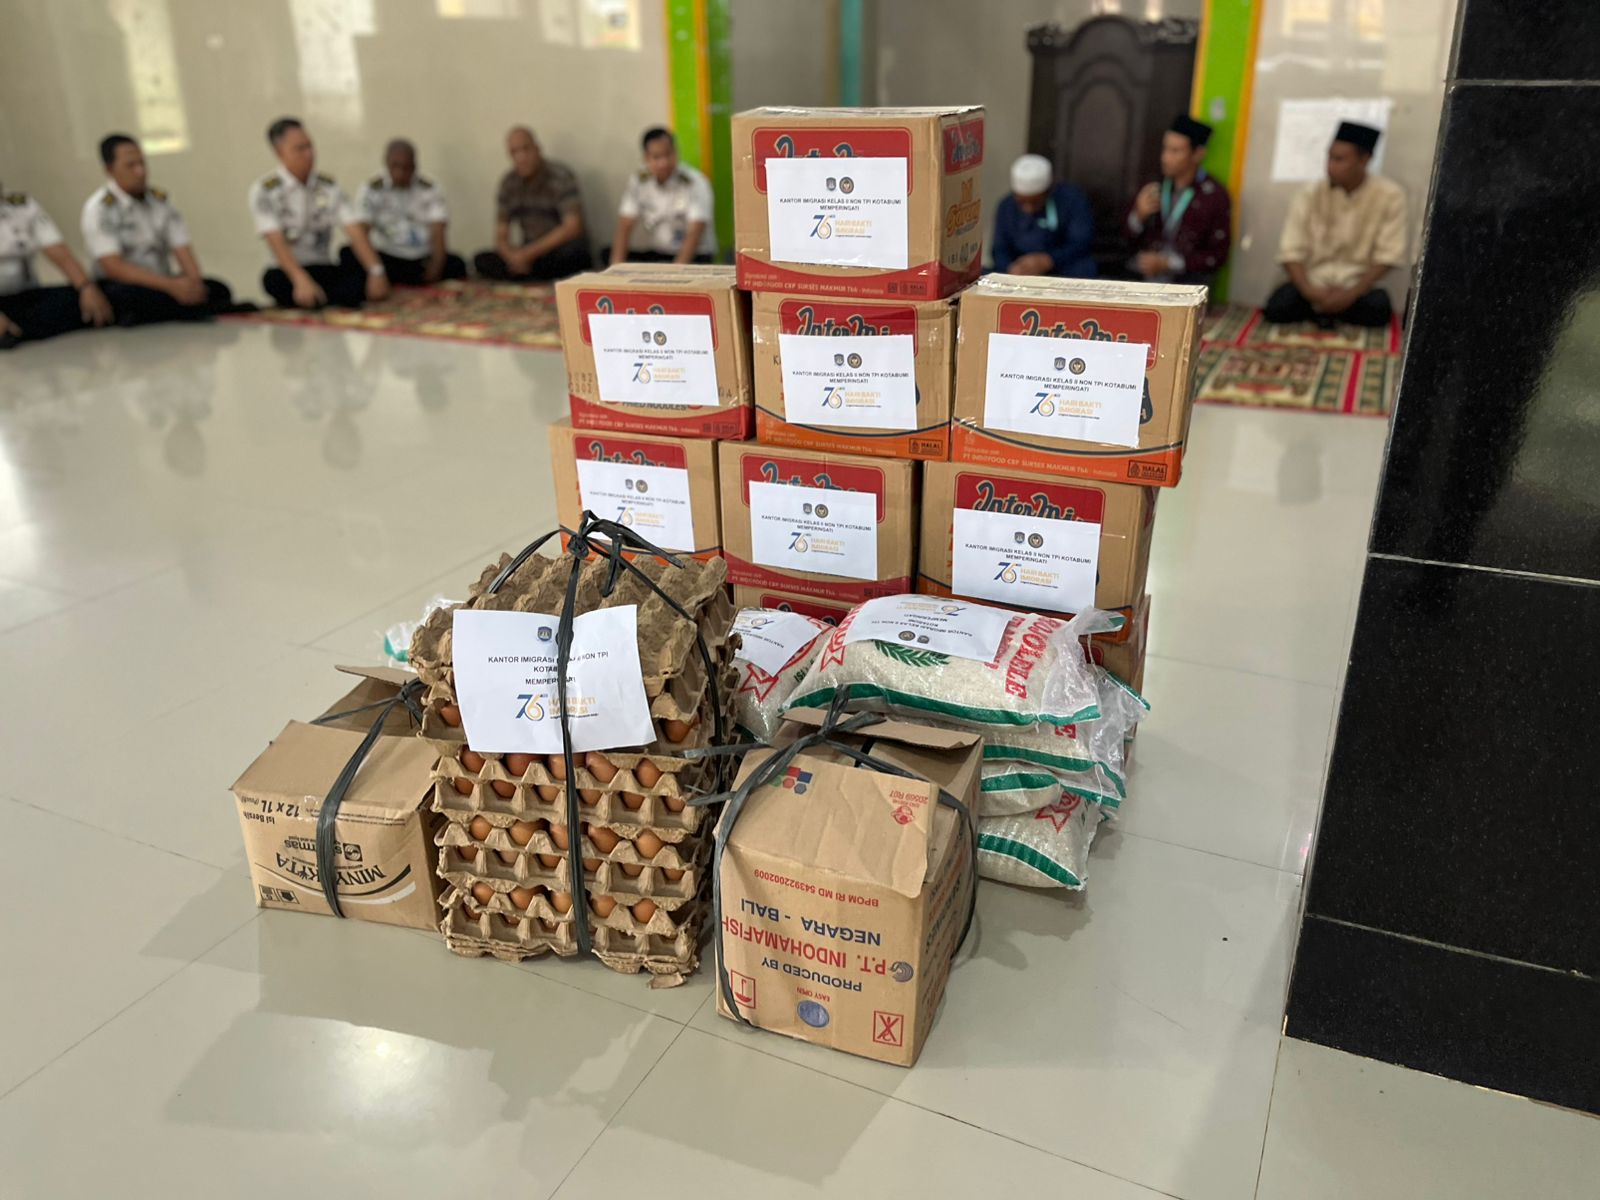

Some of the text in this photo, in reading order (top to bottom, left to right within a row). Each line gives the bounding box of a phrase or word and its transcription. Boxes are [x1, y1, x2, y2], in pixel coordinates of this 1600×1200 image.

[1044, 384, 1089, 392] MEMPERINGATI
[1030, 392, 1054, 417] 76
[1006, 554, 1048, 564] MEMPERINGATI
[1061, 556, 1091, 564] KOTABUMI
[515, 693, 545, 721] 76
[261, 800, 272, 813] 1L
[277, 802, 284, 812] x
[286, 804, 300, 817] 12
[243, 811, 275, 824] Isi Bersih
[754, 869, 879, 907] BPOM RI MD 543922002009
[741, 898, 779, 922] BALI
[801, 916, 880, 946] NEGARA
[857, 955, 886, 975] P.T.
[761, 957, 862, 992] PRODUCED BY
[797, 987, 830, 1002] EASY OPEN
